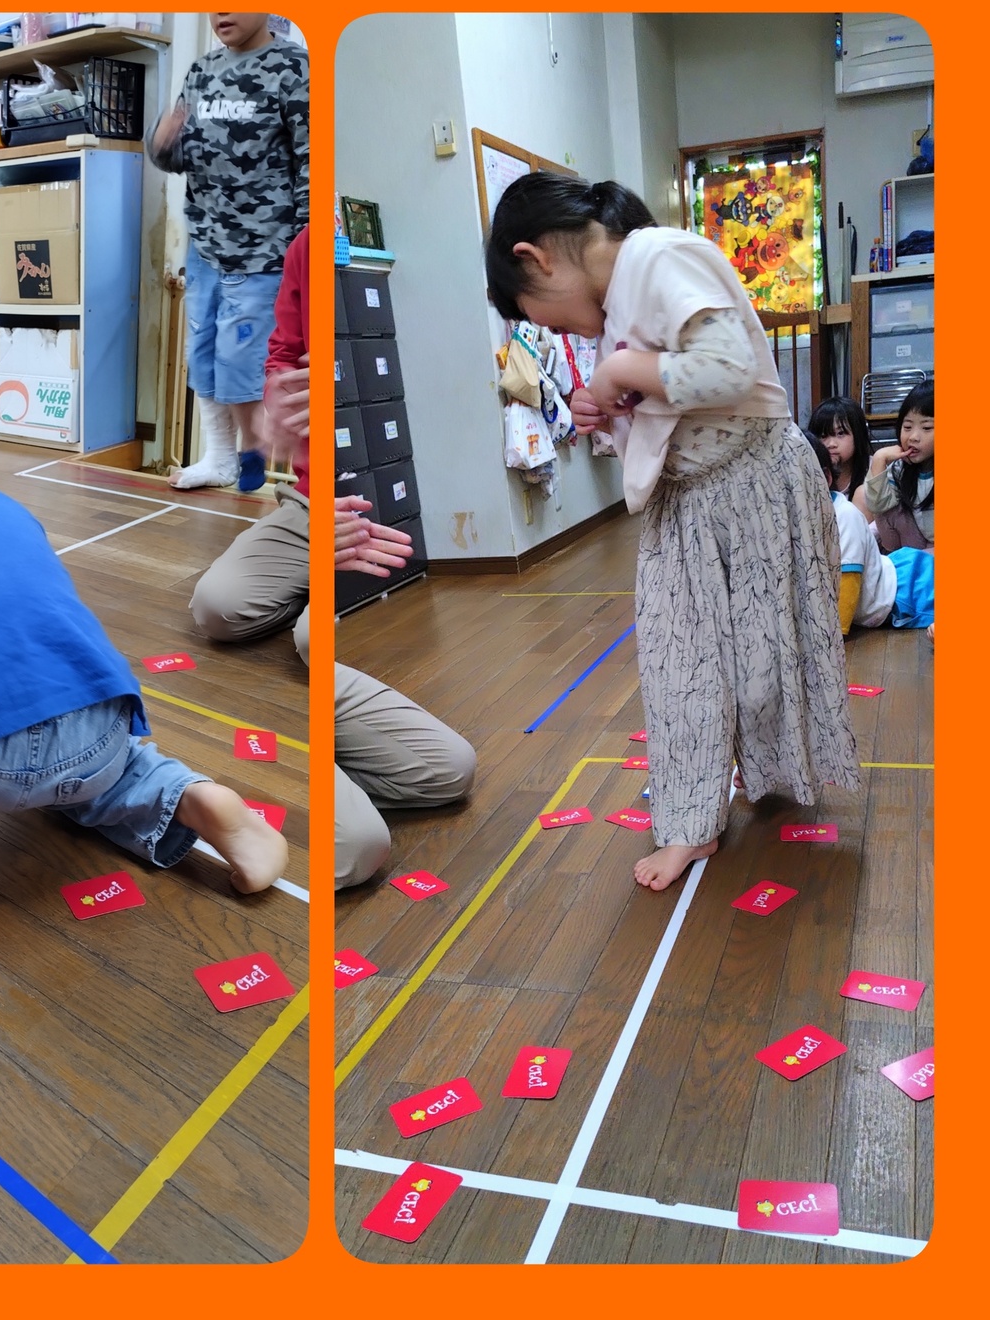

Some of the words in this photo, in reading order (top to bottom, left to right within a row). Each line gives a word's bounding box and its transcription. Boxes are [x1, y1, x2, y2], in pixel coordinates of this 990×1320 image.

[17, 253, 51, 282] みかん
[37, 389, 71, 405] みかん
